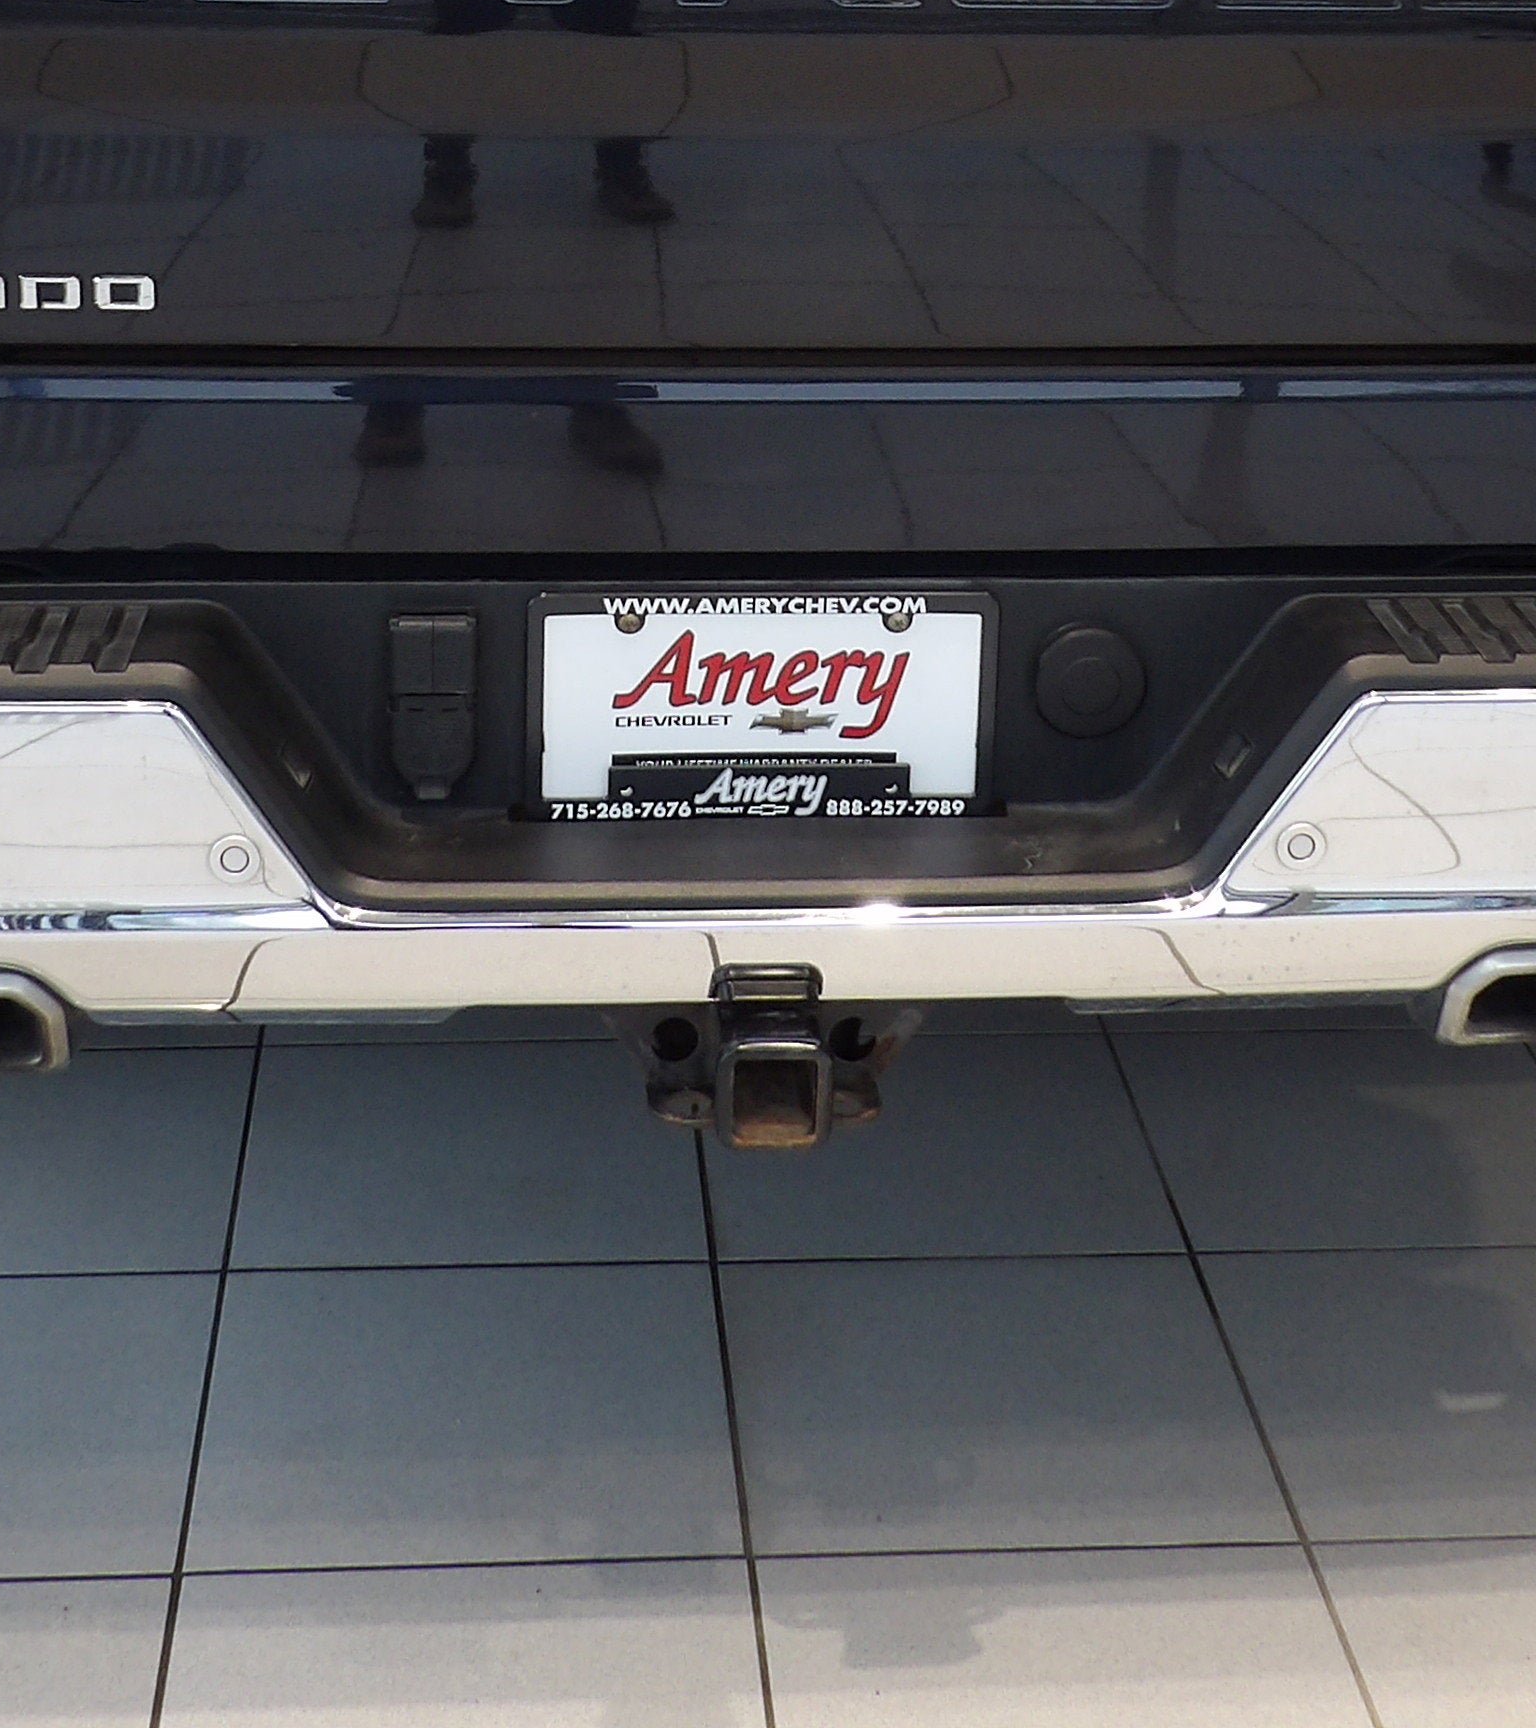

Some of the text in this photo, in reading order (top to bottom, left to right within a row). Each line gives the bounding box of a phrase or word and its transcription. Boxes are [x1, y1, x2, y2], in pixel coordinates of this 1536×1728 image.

[602, 596, 927, 615] WWW.AMERYCHEV.COM
[612, 629, 910, 739] Amery
[614, 714, 733, 728] CHEVROLET
[694, 767, 828, 816] Amery
[551, 801, 692, 820] 715-268-7676
[826, 798, 965, 816] 888-257-7989
